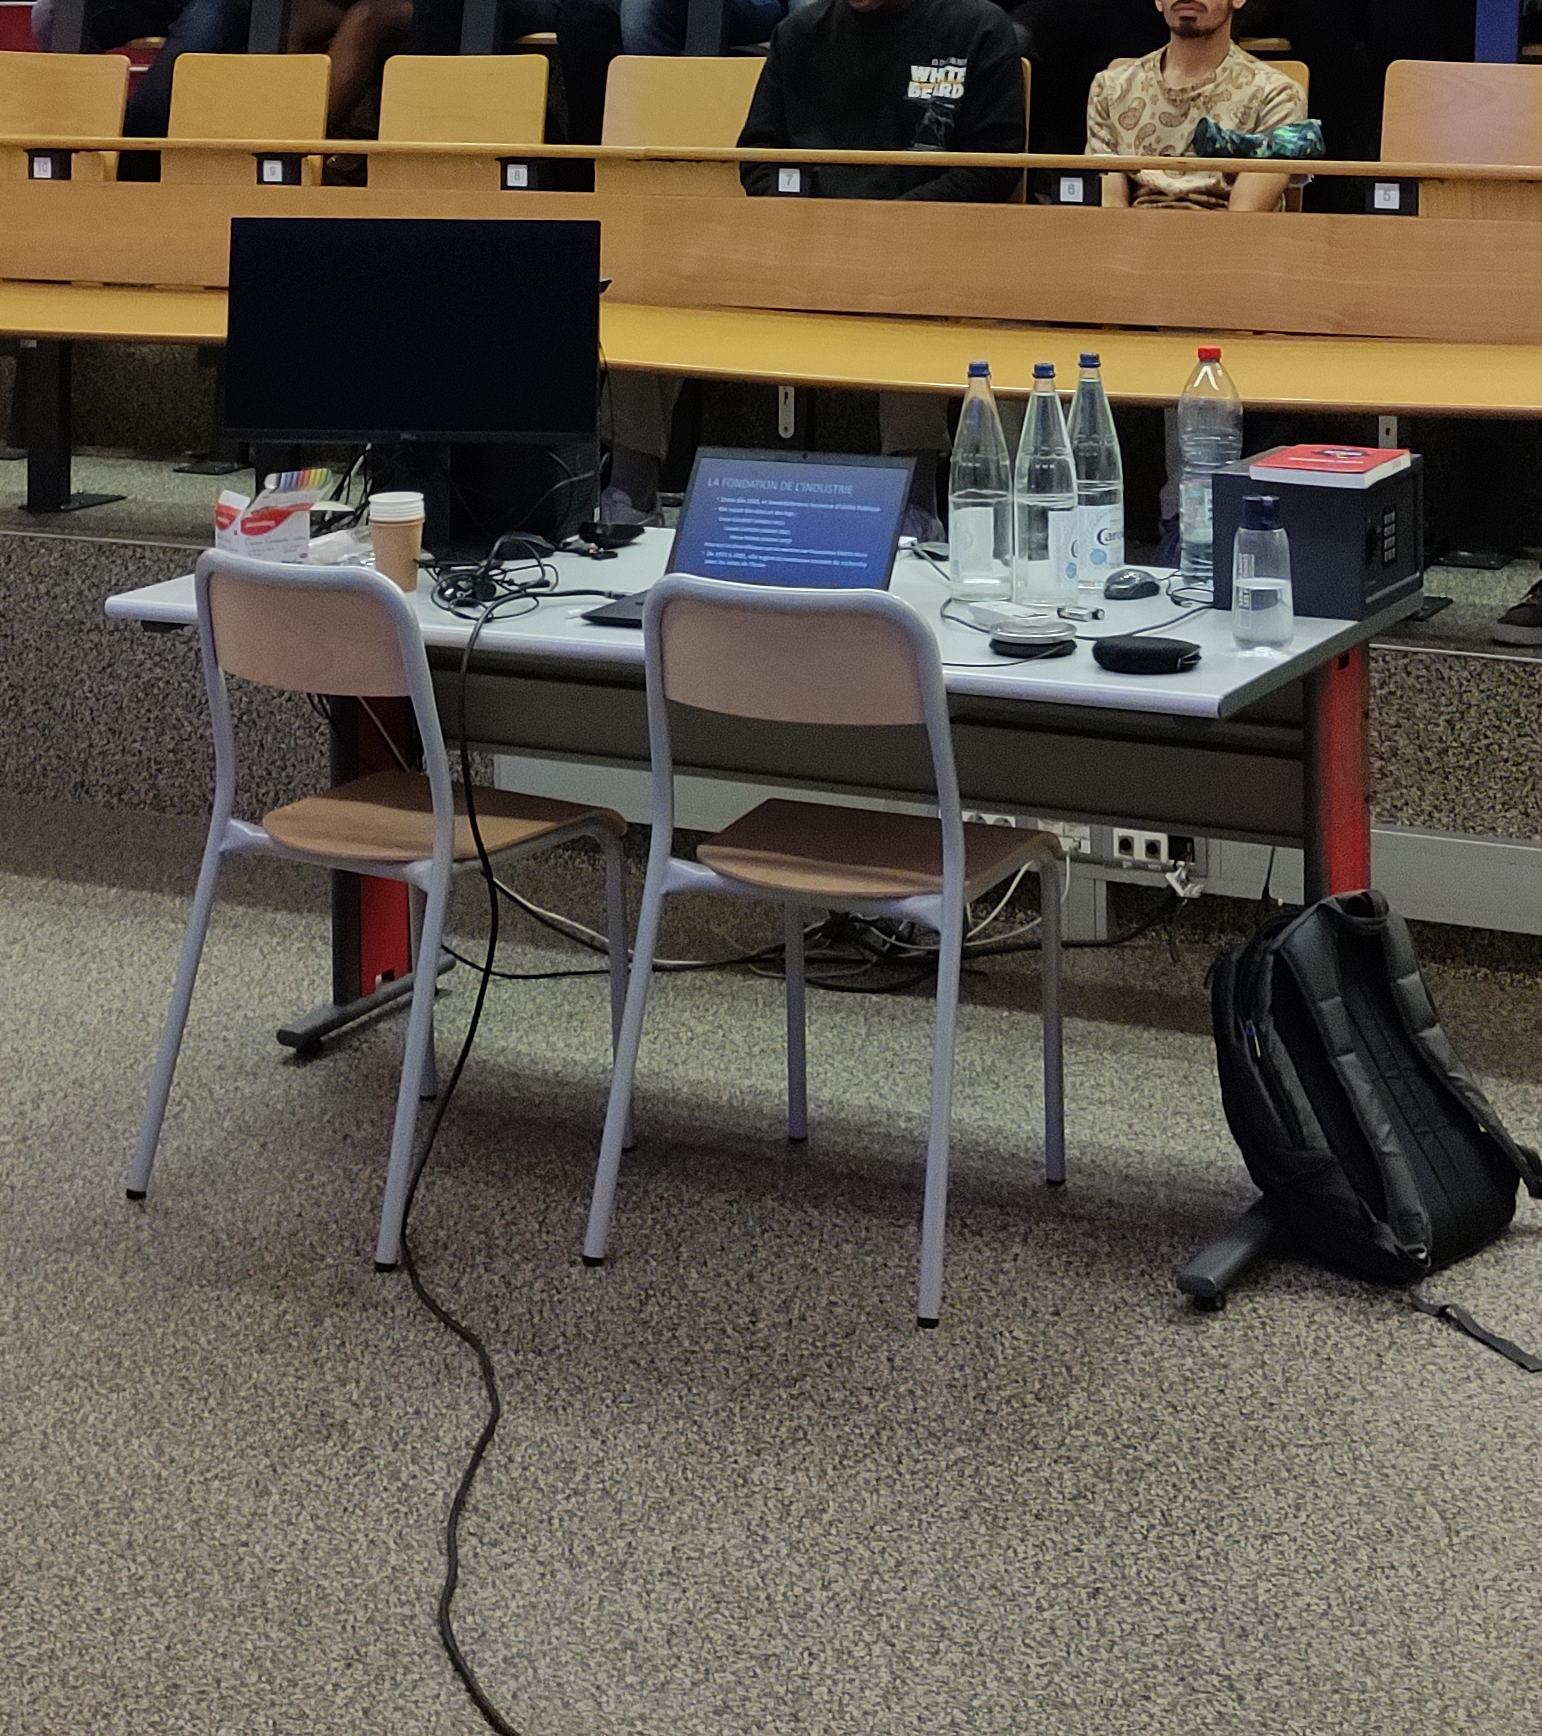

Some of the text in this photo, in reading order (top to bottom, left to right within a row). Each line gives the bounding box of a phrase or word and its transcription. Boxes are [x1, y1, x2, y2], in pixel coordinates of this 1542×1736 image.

[910, 65, 967, 83] WHITE
[270, 166, 276, 177] 9
[514, 170, 521, 181] 8
[786, 174, 794, 186] 7
[1067, 183, 1076, 195] 6
[1383, 190, 1392, 202] 5
[708, 477, 854, 495] LA FONDATION DE L'INDUSTRIE
